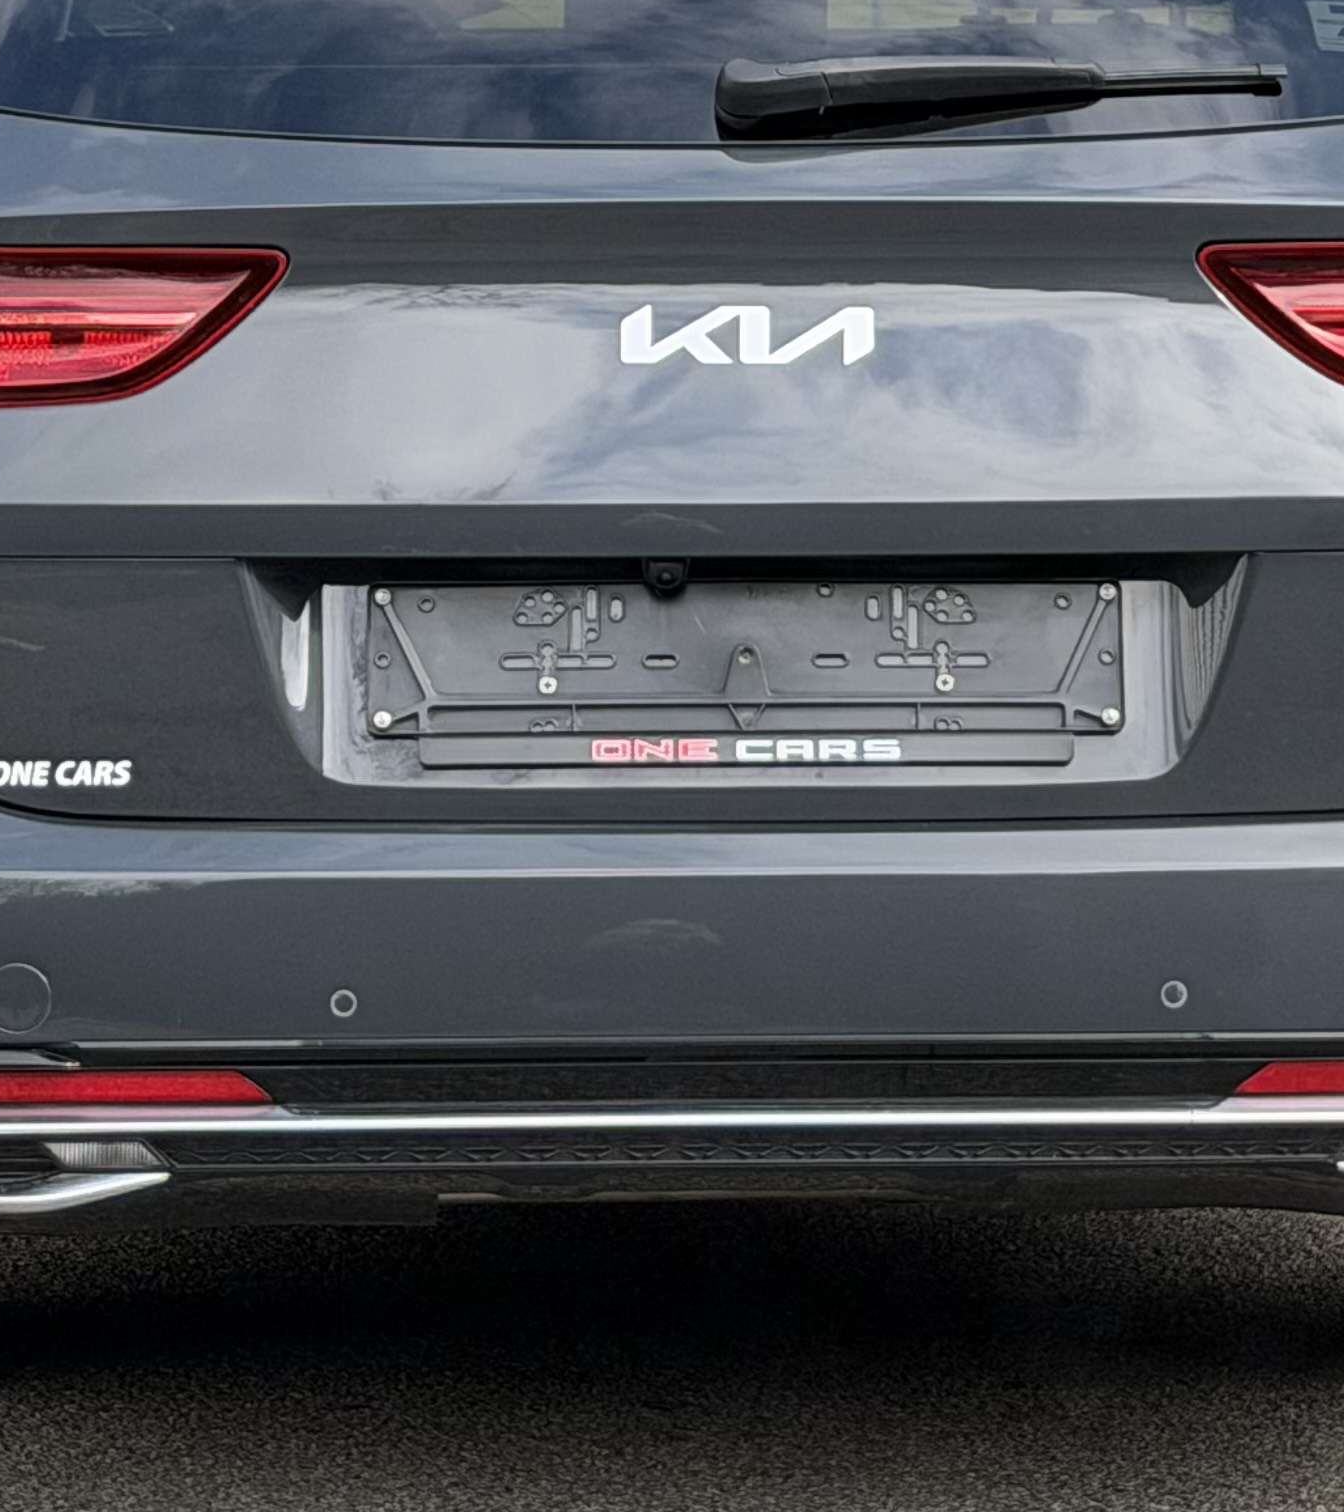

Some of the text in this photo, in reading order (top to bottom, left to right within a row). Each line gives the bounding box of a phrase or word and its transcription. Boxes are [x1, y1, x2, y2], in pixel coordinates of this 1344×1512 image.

[620, 304, 875, 365] KIA
[591, 738, 903, 762] ONE CARS
[55, 760, 133, 787] CARS
